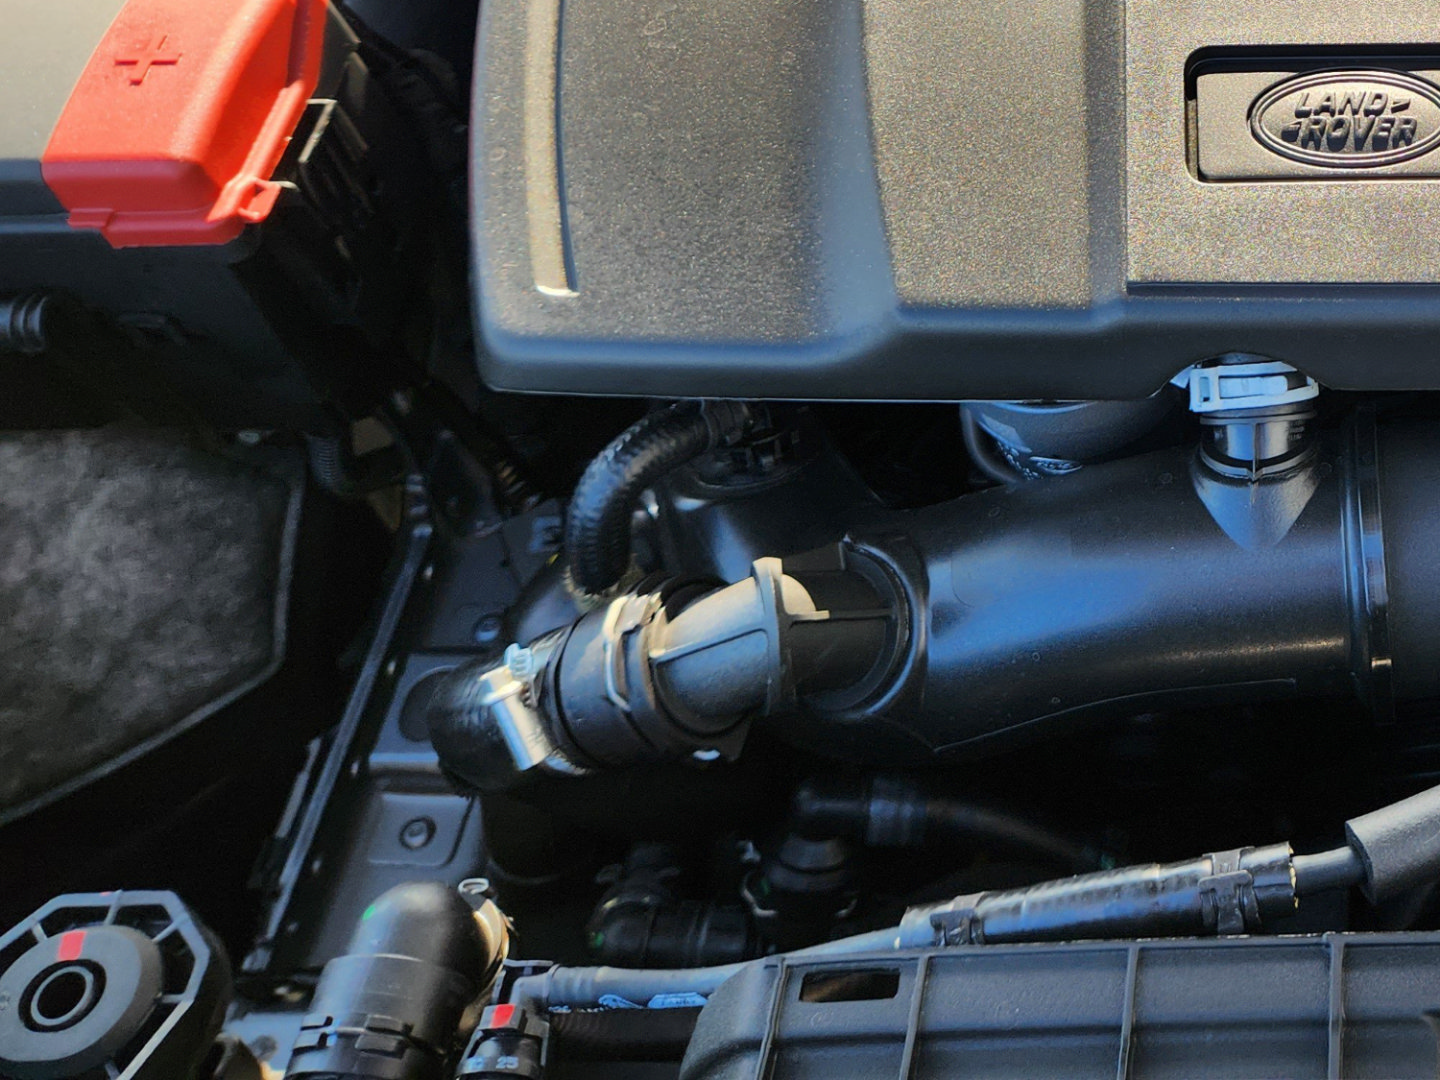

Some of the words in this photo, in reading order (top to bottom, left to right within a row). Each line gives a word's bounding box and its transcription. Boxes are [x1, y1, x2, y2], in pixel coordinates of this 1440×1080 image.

[1294, 91, 1389, 118] LAND
[1300, 115, 1418, 152] ROVER
[496, 1056, 520, 1069] 25
